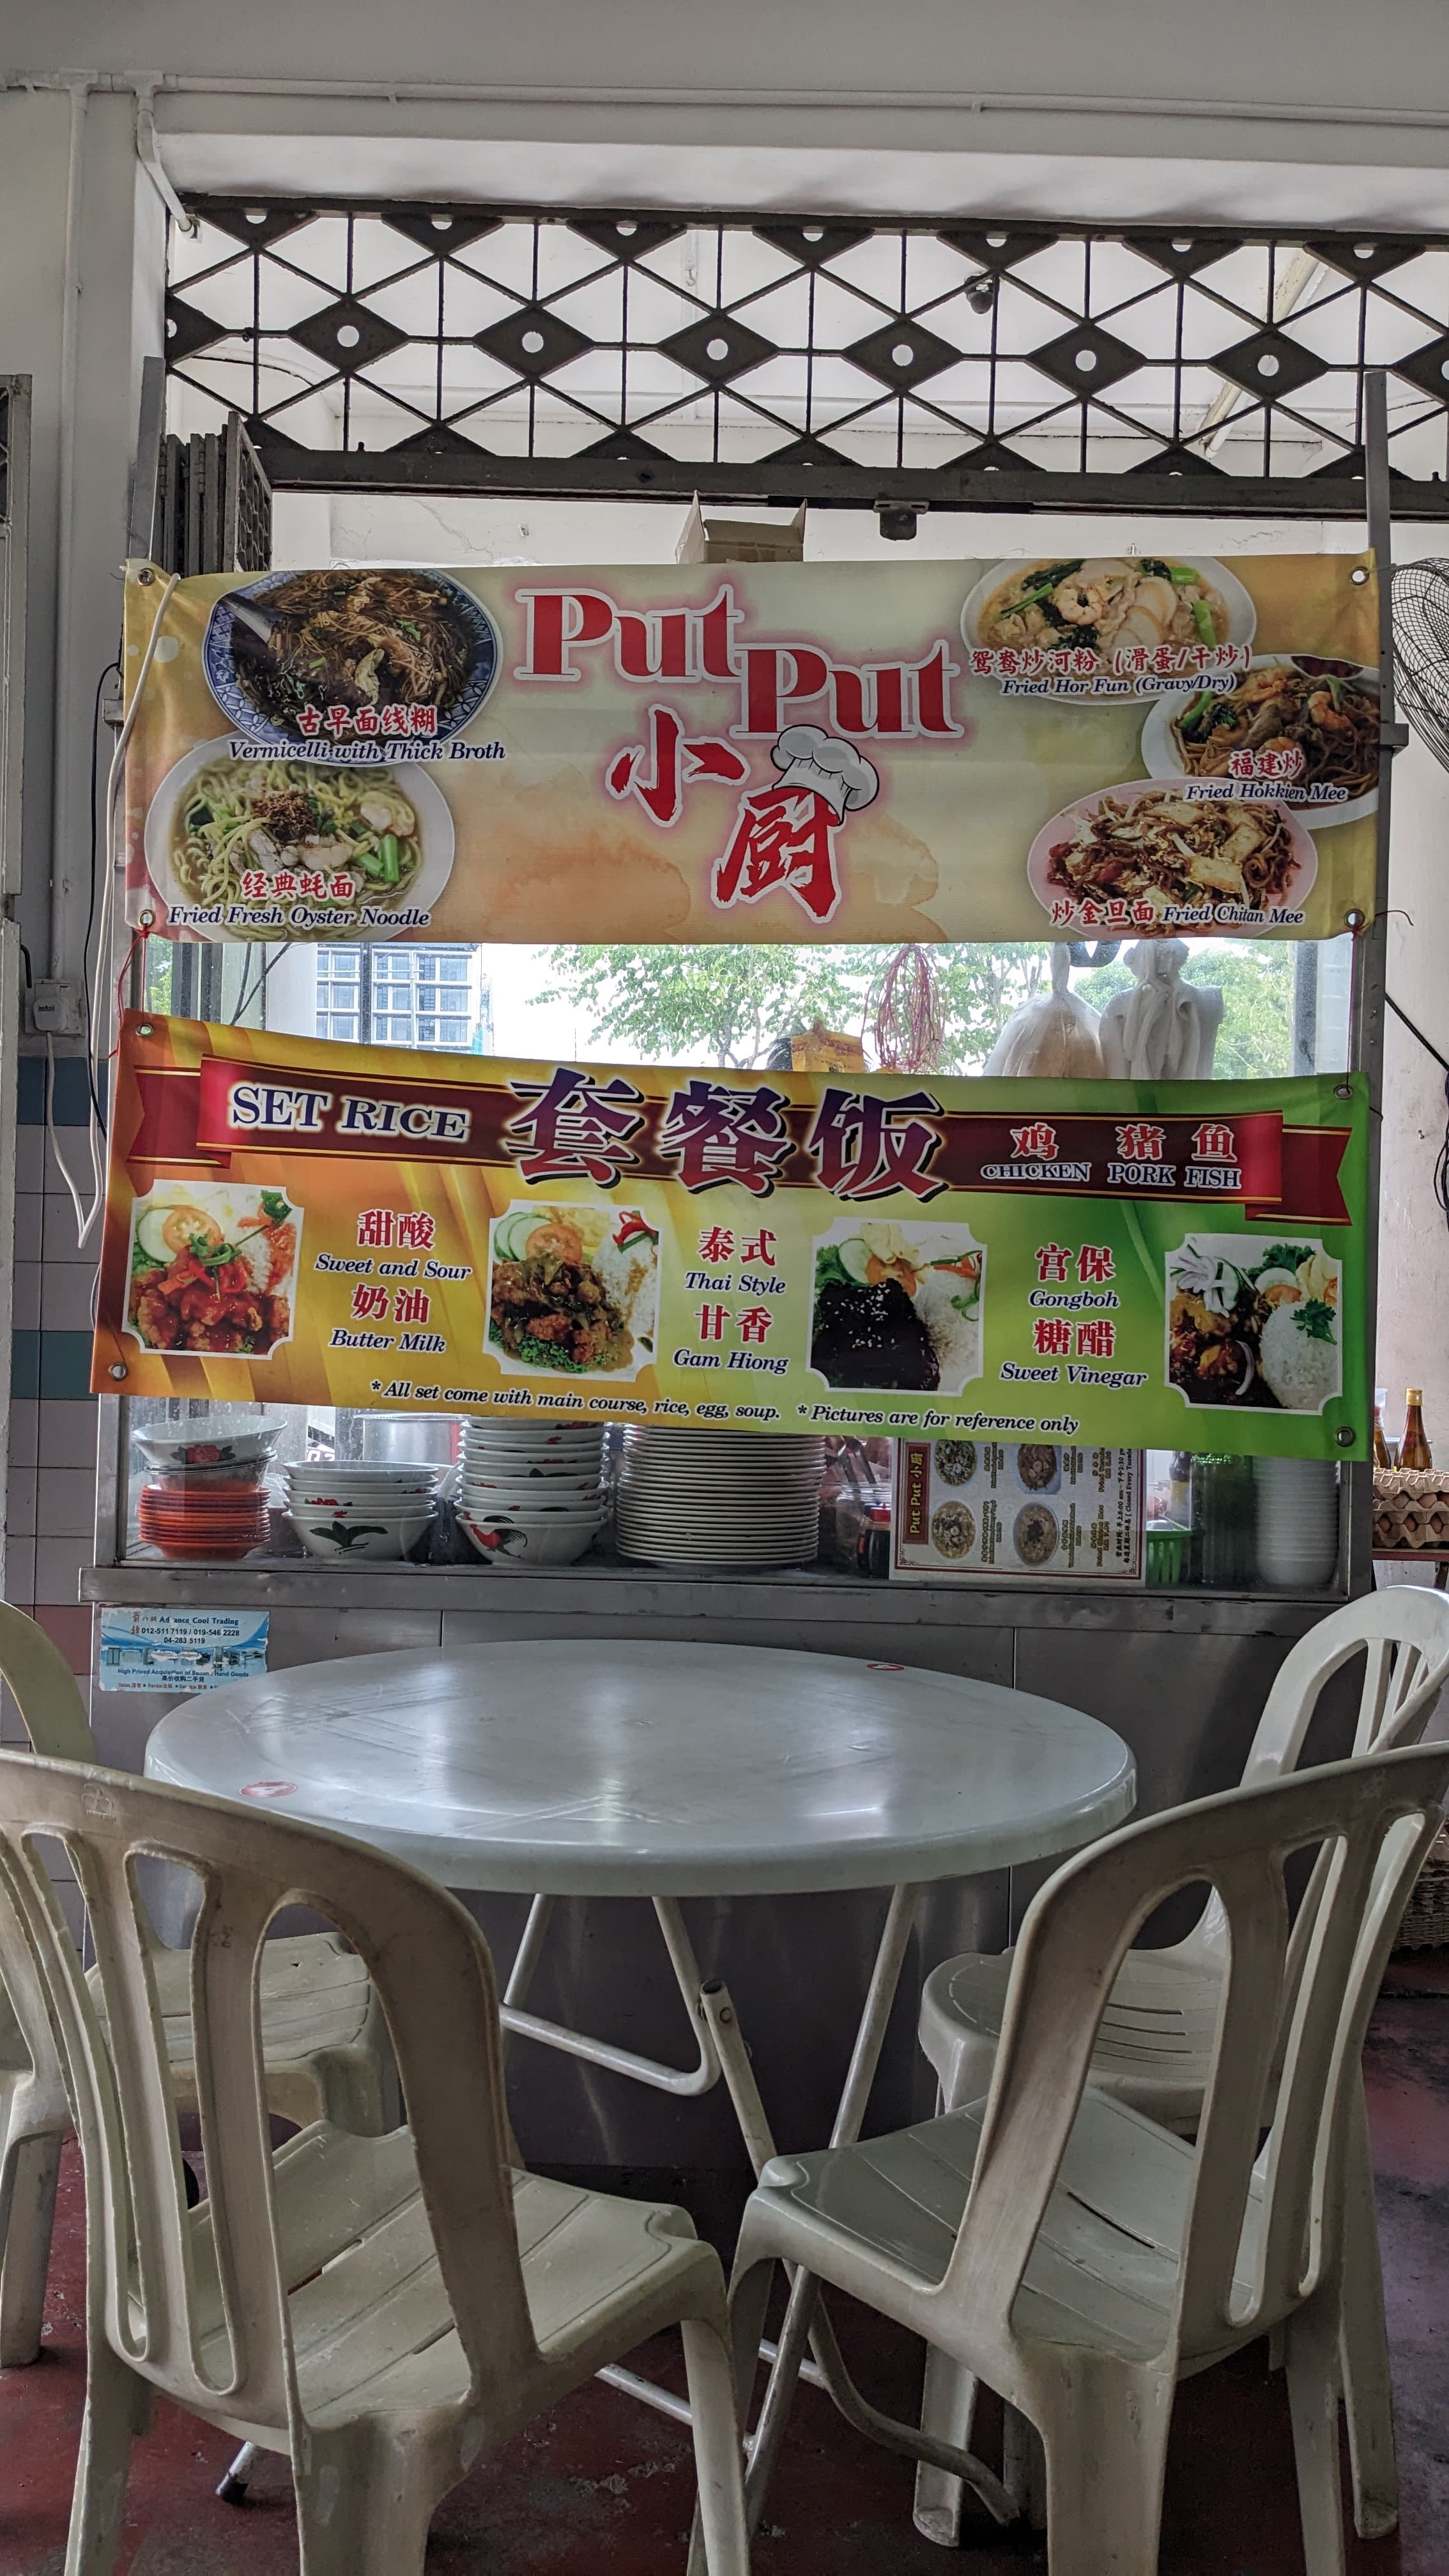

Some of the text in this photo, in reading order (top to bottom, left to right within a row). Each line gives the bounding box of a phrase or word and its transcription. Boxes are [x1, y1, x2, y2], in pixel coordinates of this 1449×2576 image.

[521, 585, 740, 677] Put
[972, 646, 1250, 674] 鸳鸯炒河粉 (滑蛋/干炒)
[735, 644, 960, 734] Put
[1002, 674, 1236, 693] Fried Hor Fun (Gravy/Dry)
[298, 704, 438, 735] 古早面线糊
[230, 741, 505, 760] Vermicelli with Thick Broth
[1232, 751, 1301, 776] 福建炒
[1186, 784, 1346, 800] Fried Hokkien Mee
[242, 872, 355, 899] 经典蚝面
[169, 906, 429, 926] Fried Fresh Oyster Noodle
[1052, 901, 1154, 924] 炒金旦面
[1163, 905, 1303, 923] Fried Chitan Mee
[233, 1085, 468, 1138] SET RICE
[509, 1068, 951, 1202] 套餐饭
[1010, 1122, 1237, 1163] 鸡 猪 鱼
[980, 1162, 1241, 1190] CHICKEN PORK FISH
[358, 1209, 436, 1249] 甜酸
[699, 1227, 778, 1267] 泰式
[315, 1254, 471, 1280] Sweet and Sour
[1036, 1243, 1116, 1282] 宫保
[685, 1272, 786, 1296] Thai Style
[351, 1284, 429, 1324] 奶油
[1029, 1290, 1119, 1310] Gongboh
[695, 1305, 773, 1343] 甘香
[330, 1330, 446, 1353] Butter Milk
[1033, 1318, 1116, 1358] 糖醋
[673, 1348, 789, 1374] Gam Hiong
[1000, 1363, 1147, 1388] Sweet Vinegar
[385, 1383, 409, 1398] All
[415, 1384, 439, 1399] set
[445, 1388, 488, 1402] come
[493, 1388, 532, 1405] with
[537, 1393, 583, 1408] main
[589, 1398, 649, 1413] course,
[654, 1399, 689, 1416] rice,
[696, 1404, 730, 1420] egg,
[735, 1406, 781, 1422] soup.
[811, 1405, 884, 1425] Pictures
[889, 1411, 919, 1425] are
[923, 1409, 950, 1429] for
[955, 1413, 1036, 1430] reference
[1040, 1416, 1080, 1436] only
[910, 1482, 922, 1506] Put
[910, 1510, 921, 1534] Put
[211, 1618, 239, 1626] Trading
